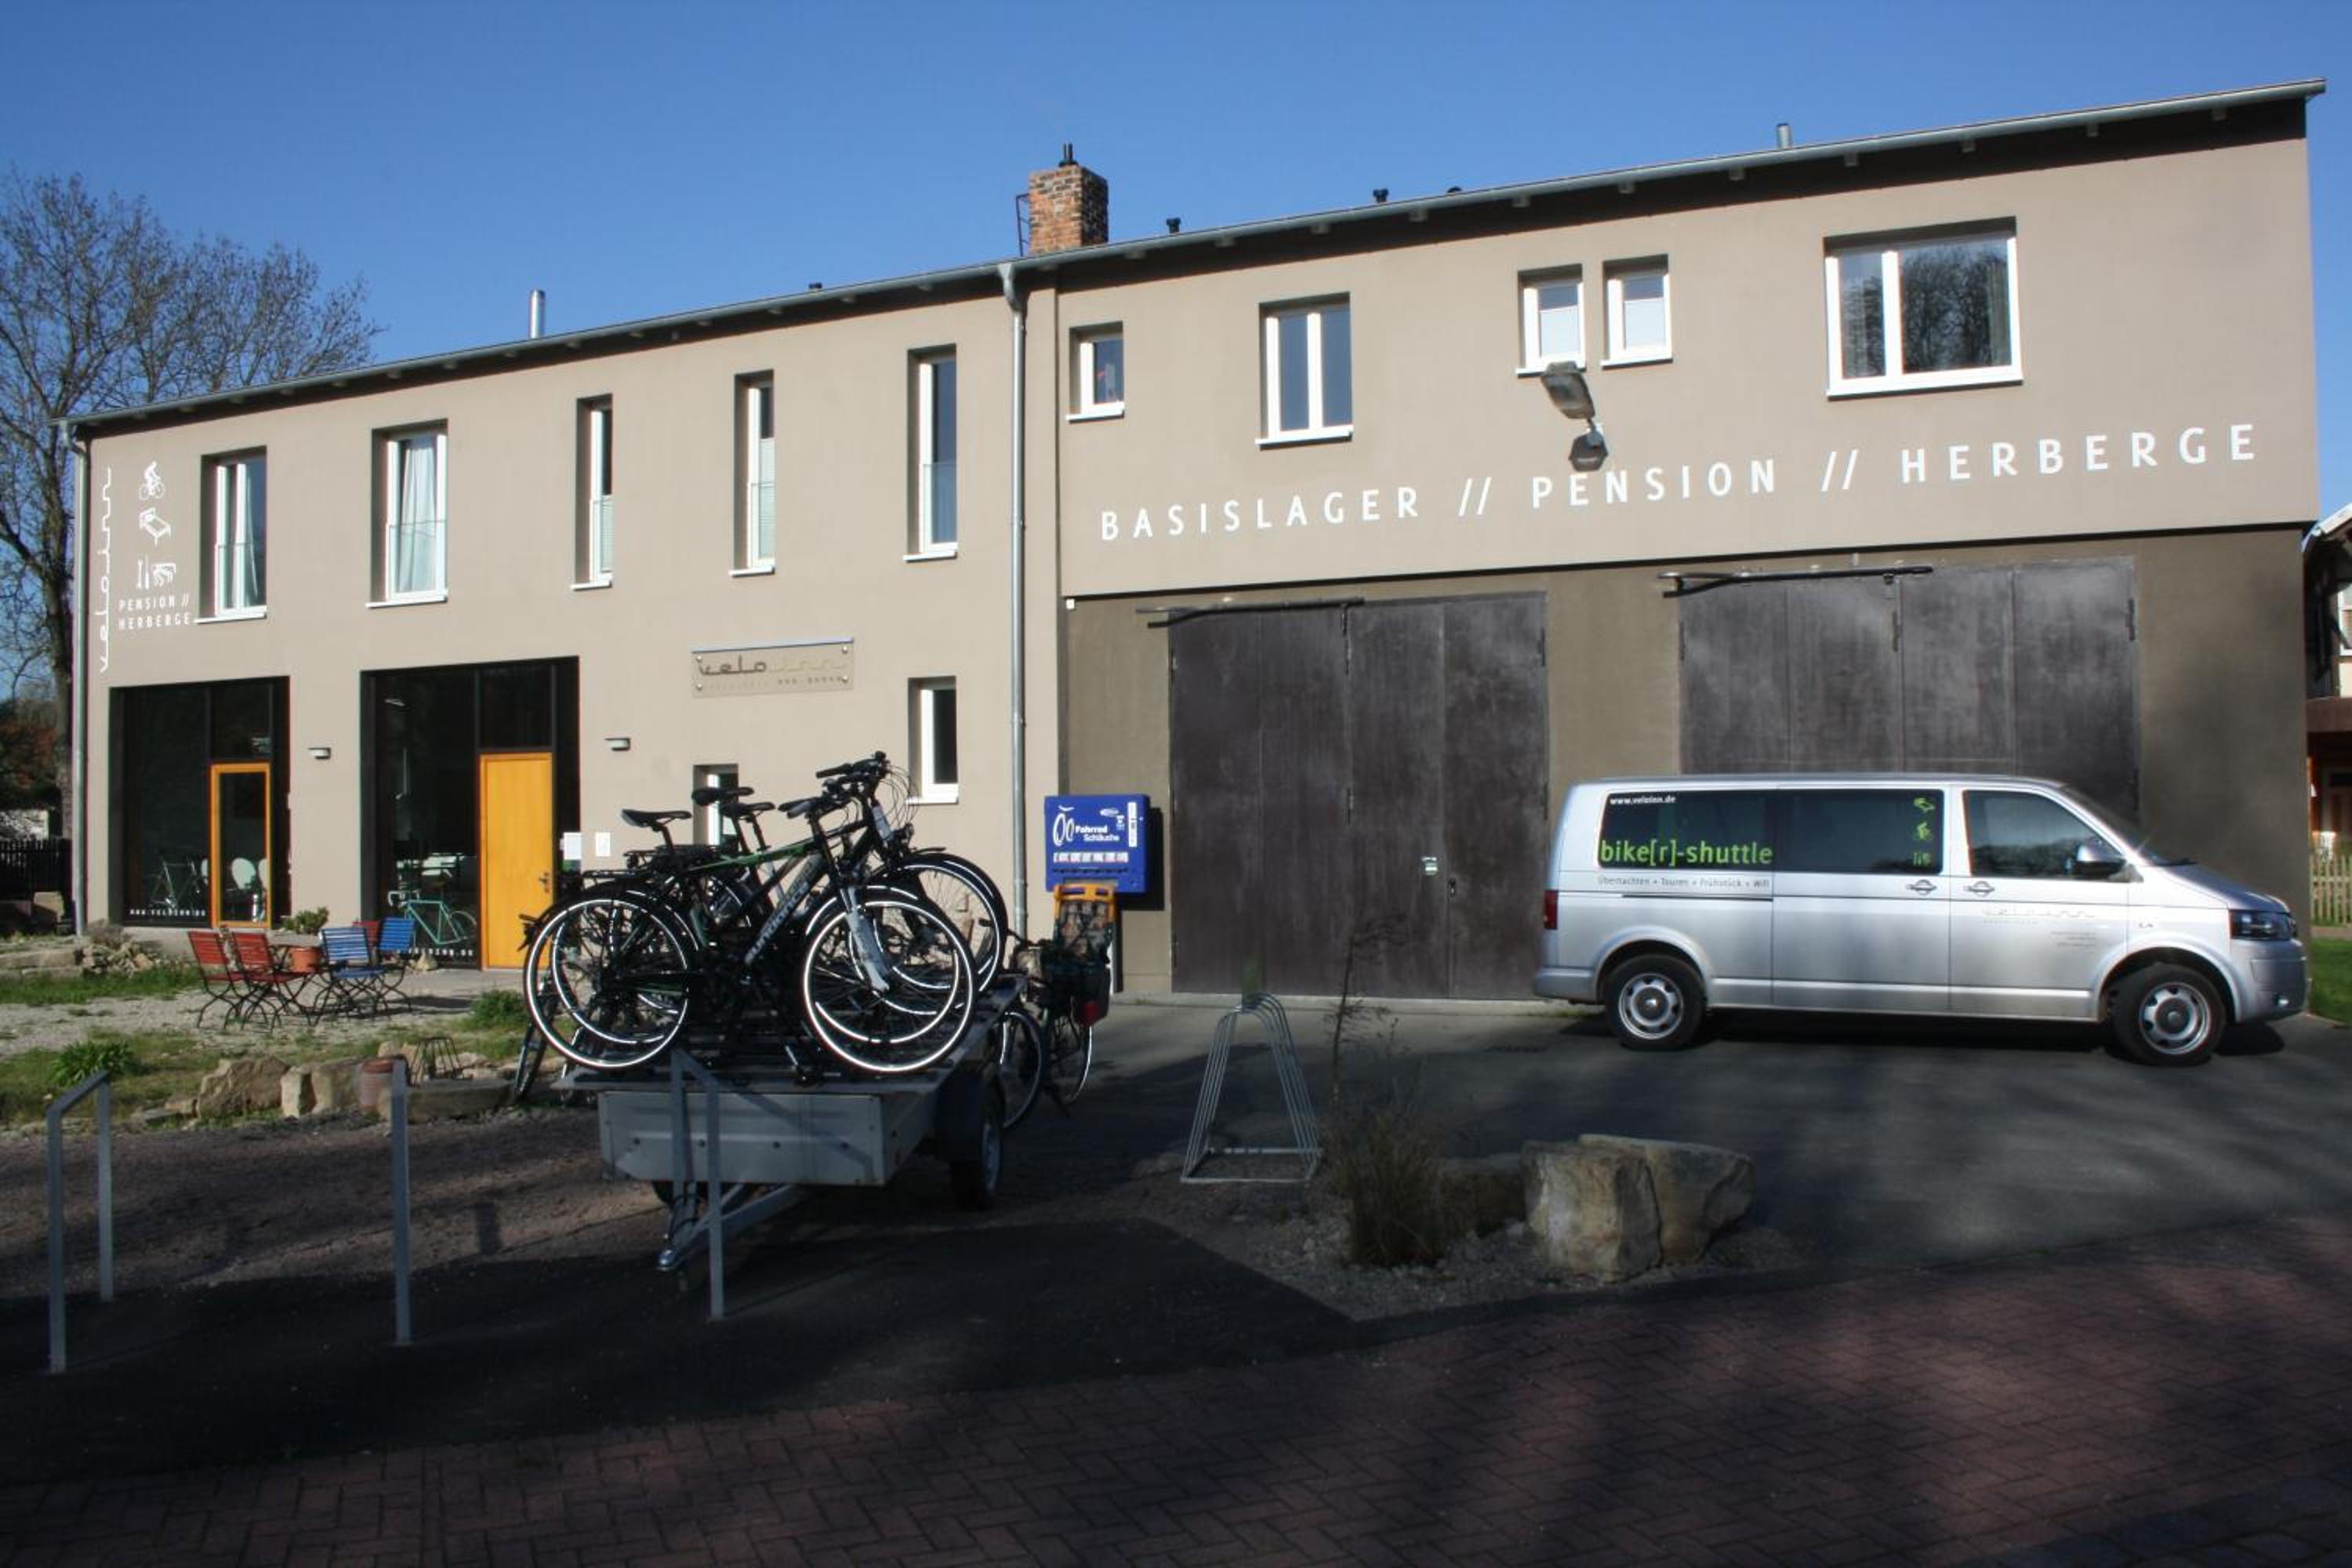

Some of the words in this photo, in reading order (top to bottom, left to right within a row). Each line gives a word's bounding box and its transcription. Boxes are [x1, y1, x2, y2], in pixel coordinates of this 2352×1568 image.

[1101, 486, 1418, 540] BASISLAGER
[1531, 459, 1775, 509] PENSION
[1900, 424, 2255, 483] HERBERGE
[118, 594, 175, 612] PENSION
[118, 612, 190, 630] HERBERGE
[1600, 838, 1774, 867] bike[r]-shuttle
